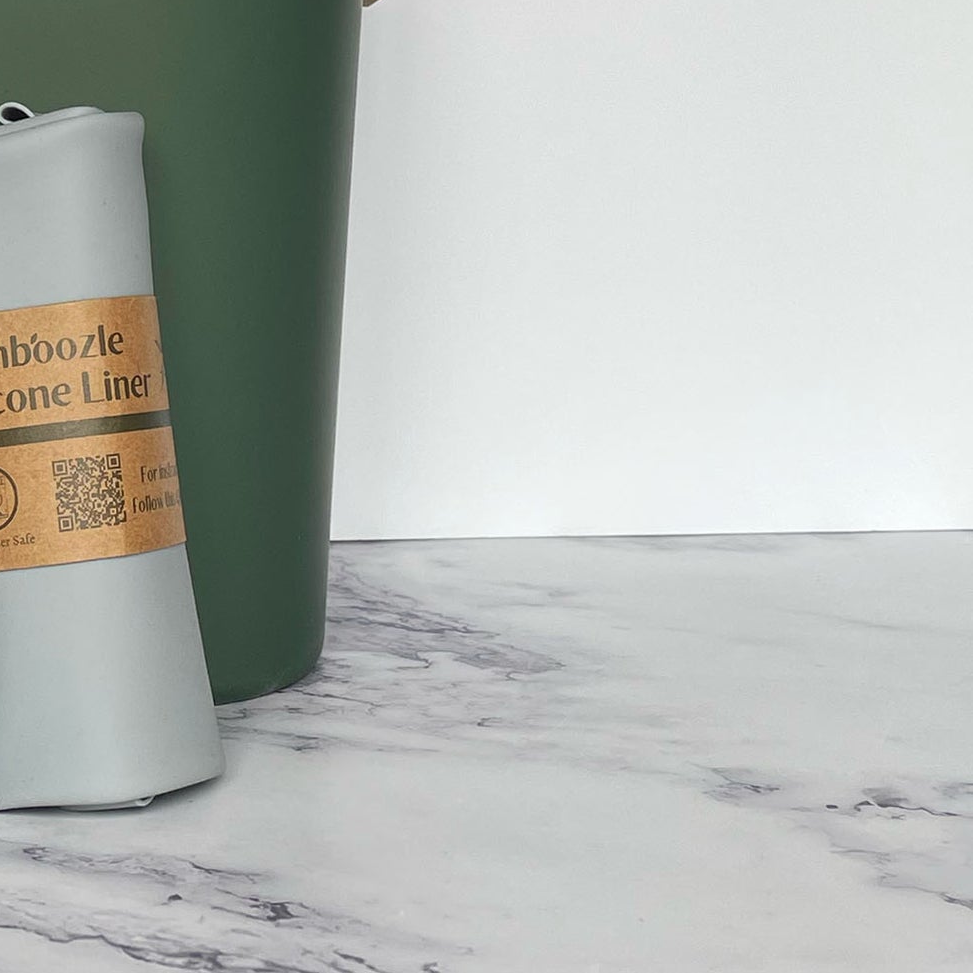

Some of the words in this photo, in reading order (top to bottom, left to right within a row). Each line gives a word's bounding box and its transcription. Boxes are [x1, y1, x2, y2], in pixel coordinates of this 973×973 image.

[82, 371, 151, 404] Liner
[140, 465, 157, 482] For
[12, 533, 35, 546] Safe
